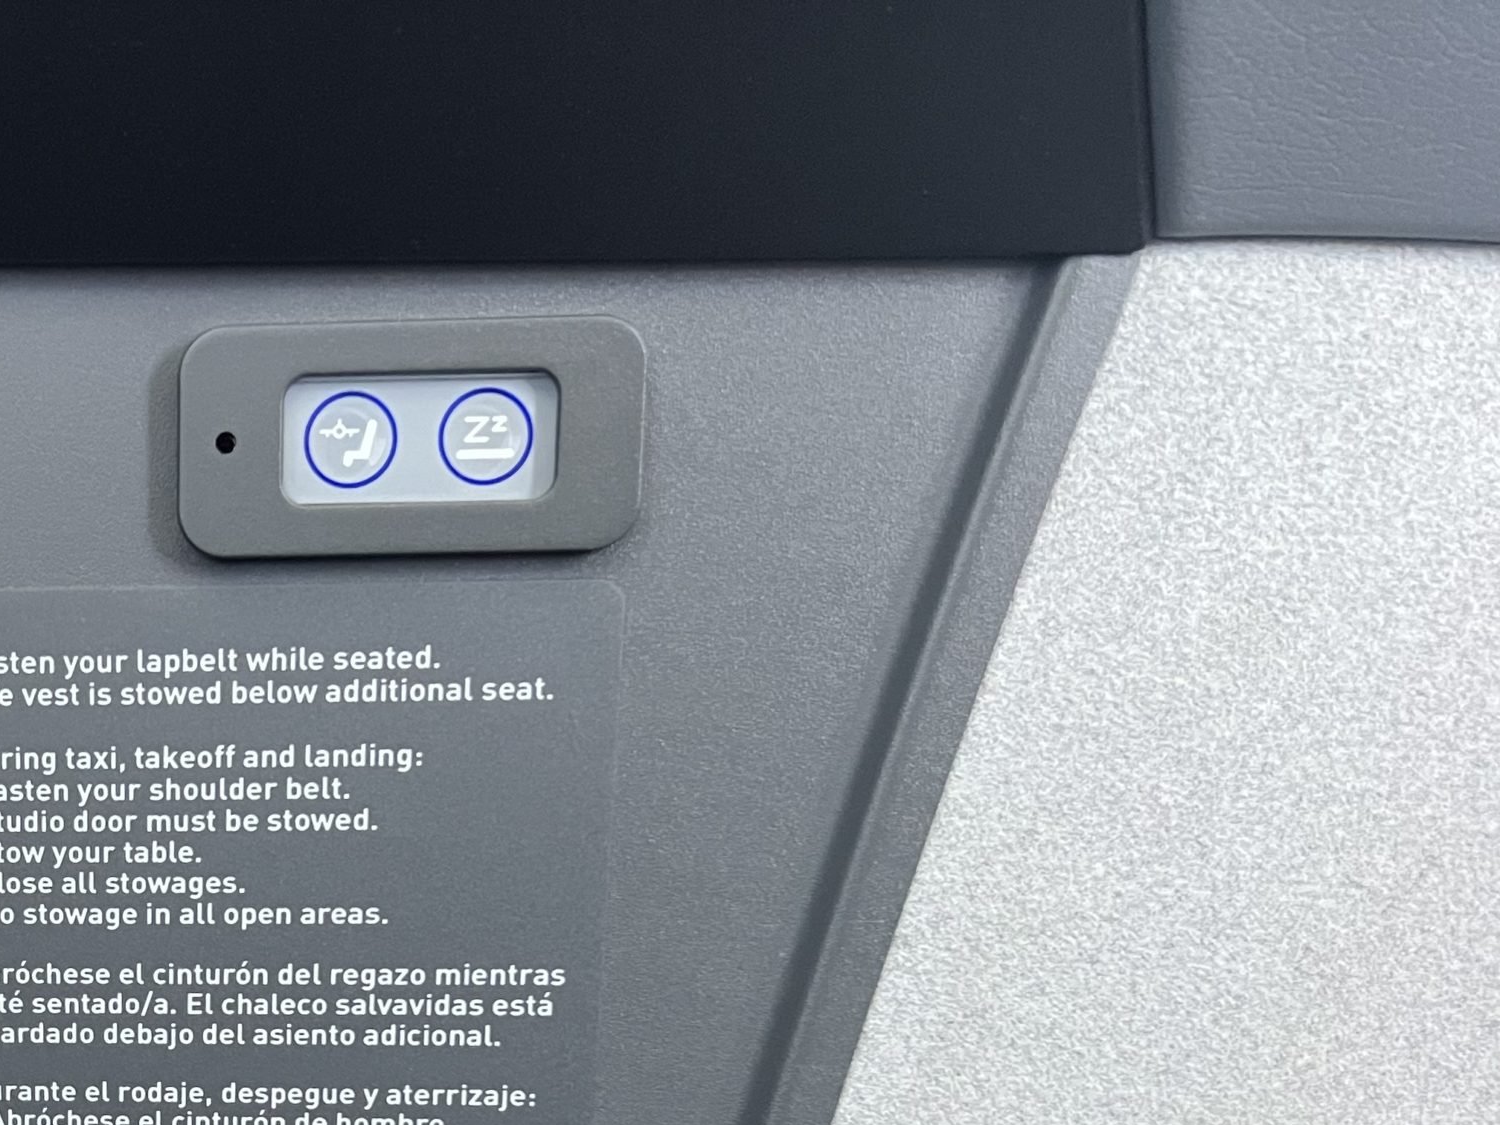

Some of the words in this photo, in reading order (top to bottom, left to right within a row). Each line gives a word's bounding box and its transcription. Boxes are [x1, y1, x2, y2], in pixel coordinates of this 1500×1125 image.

[62, 654, 129, 681] your
[136, 647, 239, 680] lapbelt
[245, 646, 325, 672] while
[332, 643, 441, 671] seated.
[21, 683, 80, 707] vest
[88, 681, 112, 707] is
[120, 680, 222, 706] stowed
[231, 679, 319, 705] below
[324, 676, 474, 704] additional
[481, 676, 554, 702] seat.
[64, 745, 126, 774] taxi,
[133, 743, 236, 770] takeoff
[242, 743, 295, 769] and
[304, 742, 424, 773] landing:
[76, 783, 142, 808] your
[149, 776, 279, 801] shoulder
[286, 775, 351, 800] belt.
[73, 809, 138, 833] door
[146, 809, 216, 833] must
[225, 808, 260, 832] be
[266, 807, 379, 832] stowed.
[51, 845, 116, 870] your
[122, 839, 202, 864] table.
[61, 871, 97, 895] all
[105, 872, 246, 900] stowages.
[23, 903, 138, 931] stowage
[146, 902, 171, 925] in
[179, 902, 216, 925] all
[223, 907, 292, 931] open
[299, 906, 389, 925] areas.
[118, 962, 145, 985] el
[152, 960, 269, 986] cinturón
[277, 962, 322, 986] del
[330, 967, 426, 992] regazo
[435, 962, 566, 987] mientras
[31, 990, 177, 1017] sentado/a.
[186, 992, 214, 1015] El
[221, 992, 328, 1016] chaleco
[335, 993, 485, 1017] salvavidas
[492, 991, 554, 1017] está
[103, 1022, 194, 1051] debajo
[202, 1022, 246, 1045] del
[252, 1023, 356, 1046] asiento
[362, 1023, 501, 1047] adicional.
[84, 1080, 110, 1103] el
[118, 1081, 212, 1109] rodaje,
[221, 1081, 356, 1108] despegue
[363, 1088, 379, 1111] y
[385, 1083, 536, 1112] aterrizaje:
